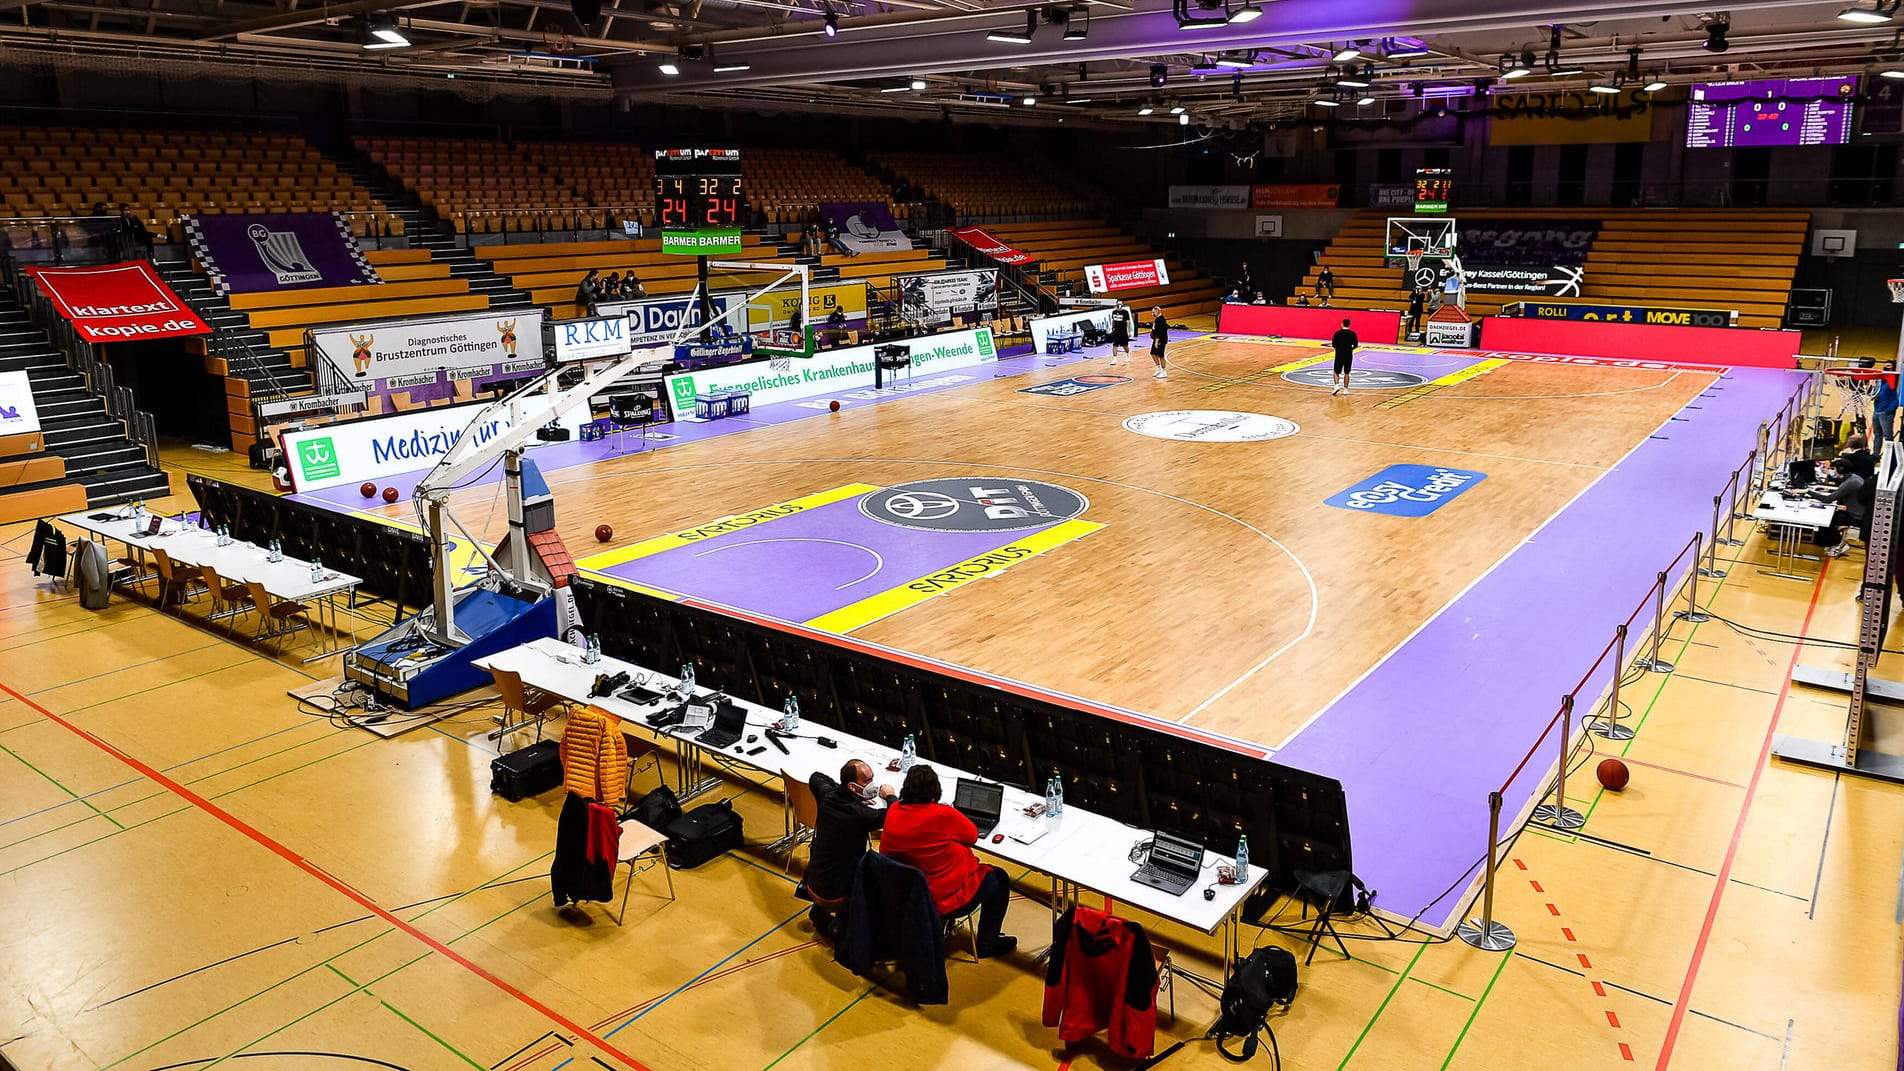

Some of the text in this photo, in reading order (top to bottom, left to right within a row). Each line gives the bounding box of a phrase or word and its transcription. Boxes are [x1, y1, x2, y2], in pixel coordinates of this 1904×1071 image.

[699, 179, 718, 195] 32
[662, 198, 687, 223] 24
[707, 198, 736, 223] 24
[251, 229, 266, 239] BG
[663, 236, 697, 246] BARMER
[698, 236, 741, 246] BARMER
[278, 272, 320, 284] GÖTTINGEN
[72, 299, 171, 318] klartext
[1538, 307, 1567, 317] ROLLI
[86, 317, 198, 340] kopie.de
[407, 333, 467, 346] Diagnostisches
[631, 332, 657, 344] MPETENZ
[375, 340, 498, 362] Brustzentrum Göttingen
[456, 367, 491, 379] Krombacher
[511, 361, 545, 373] Krombacher
[398, 374, 435, 386] Krombacher
[709, 373, 801, 396] Egelisches
[298, 396, 340, 409] Krombacher
[623, 408, 652, 418] SPALDING
[677, 503, 804, 542] SARTORIUS
[909, 545, 1032, 594] SARTORIUS
[567, 593, 580, 646] ACHIEGEL.DE
